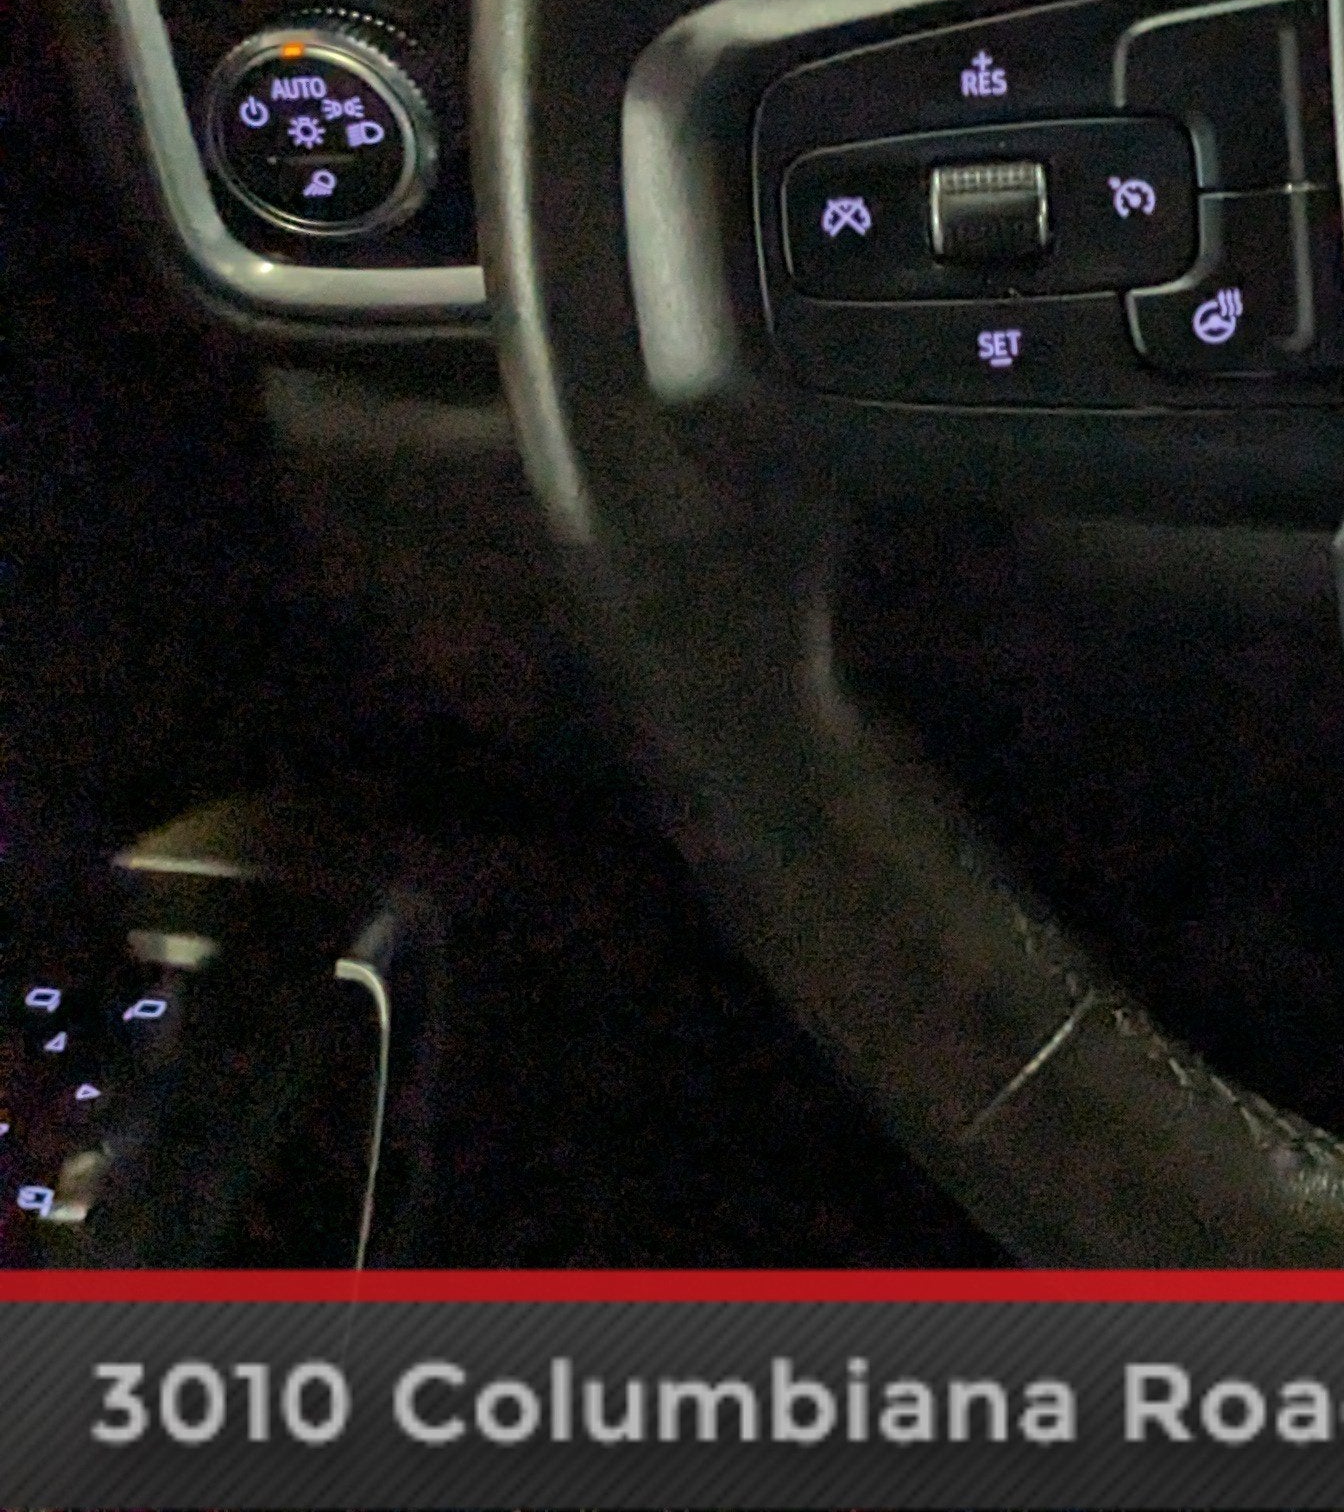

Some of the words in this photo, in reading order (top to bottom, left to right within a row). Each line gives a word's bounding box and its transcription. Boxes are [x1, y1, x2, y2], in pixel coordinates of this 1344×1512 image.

[270, 75, 328, 102] AUTO
[960, 70, 1009, 98] RES
[977, 330, 1022, 360] SET
